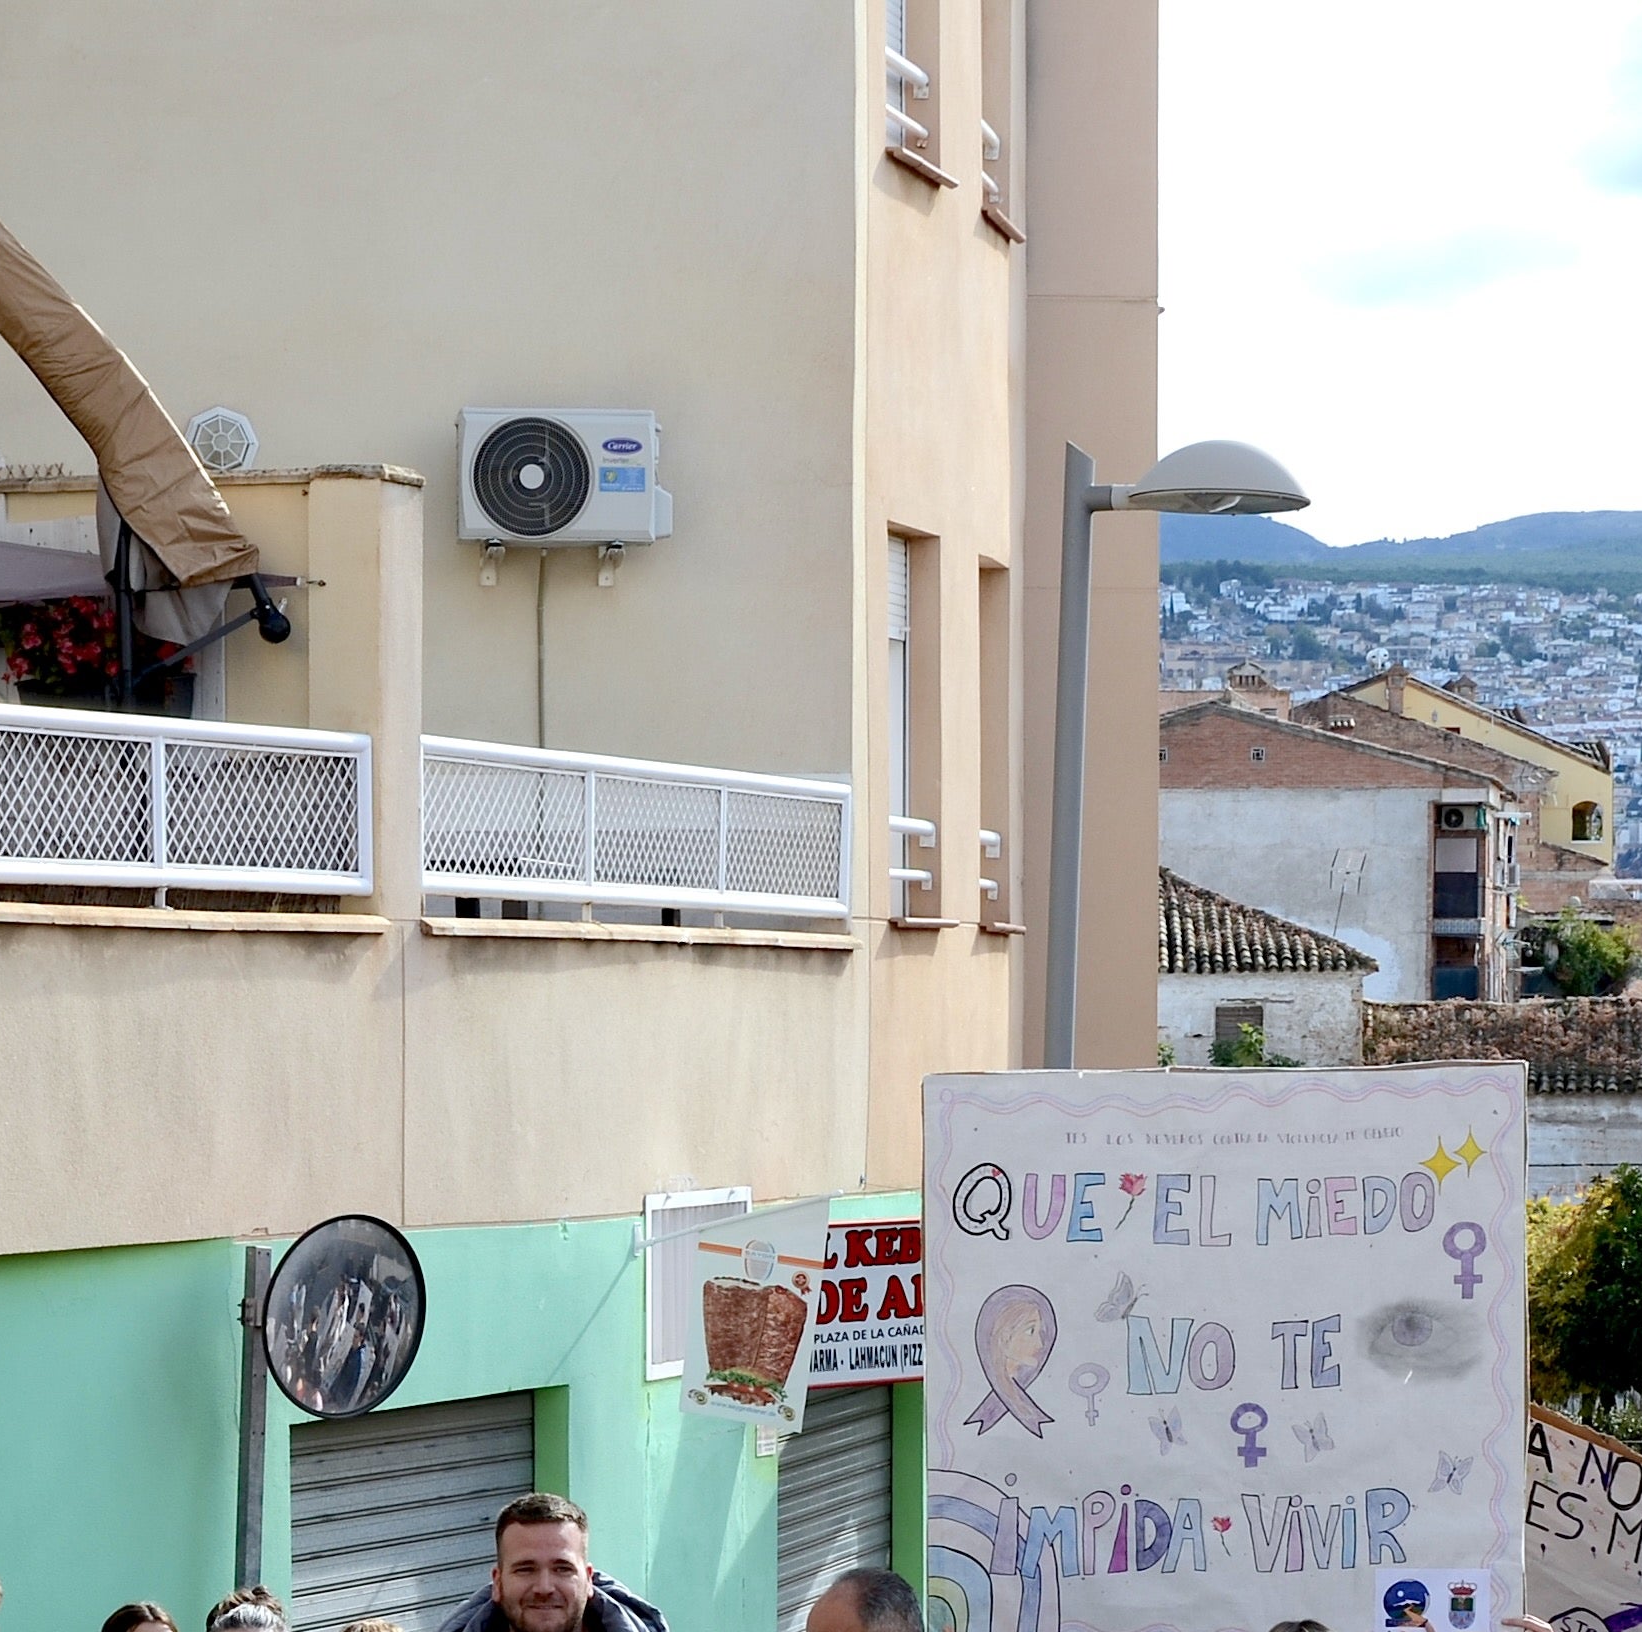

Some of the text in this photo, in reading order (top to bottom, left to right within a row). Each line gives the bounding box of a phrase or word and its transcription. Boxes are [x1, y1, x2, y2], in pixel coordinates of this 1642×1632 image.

[606, 439, 638, 451] Carrier
[953, 1162, 1106, 1242] QUE
[1153, 1173, 1232, 1247] EL
[823, 1227, 921, 1269] L KEB
[816, 1277, 869, 1325] DE
[810, 1348, 839, 1373] ARMA
[849, 1344, 898, 1371] LAHMACUN
[814, 1331, 849, 1345] PLAZA
[853, 1330, 867, 1341] DE
[871, 1328, 885, 1339] LA
[1126, 1314, 1341, 1396] NO TE
[1526, 1480, 1588, 1540] ES
